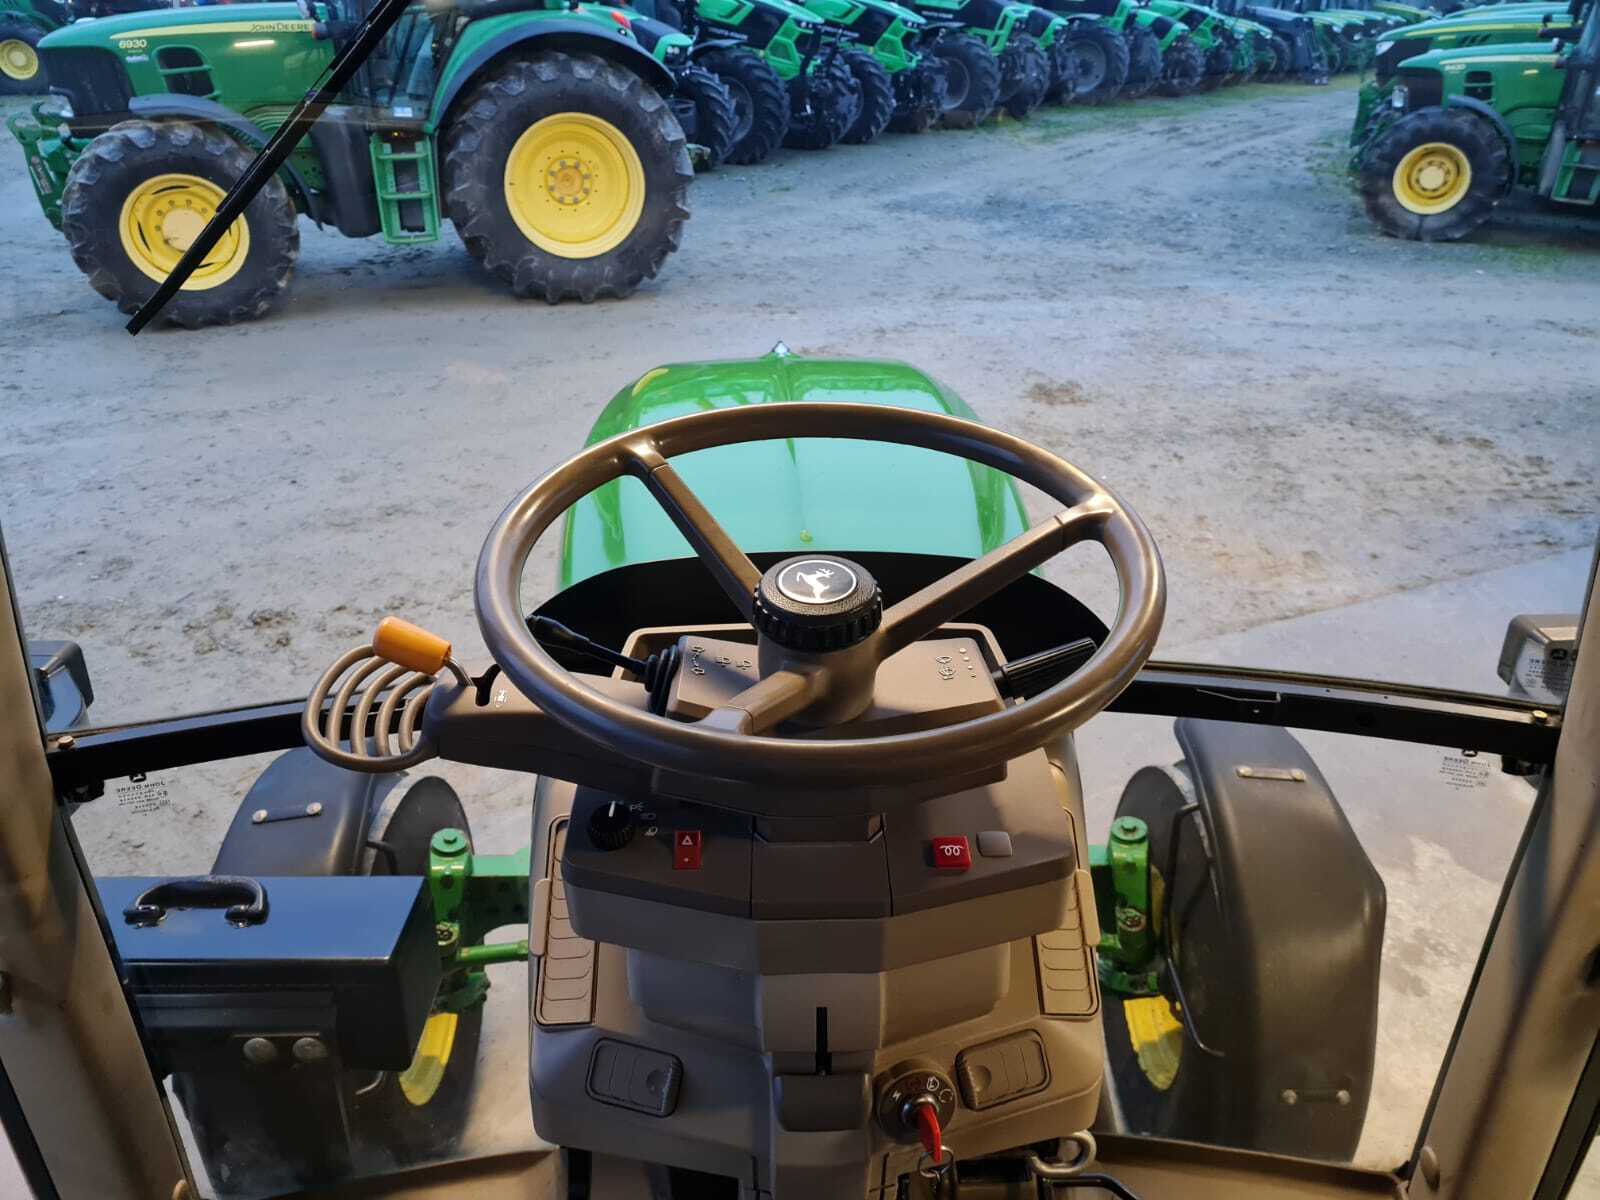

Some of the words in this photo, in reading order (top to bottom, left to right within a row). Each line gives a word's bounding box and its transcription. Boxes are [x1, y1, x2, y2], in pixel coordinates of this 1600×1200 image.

[250, 23, 275, 32] JOHN
[276, 22, 309, 32] DEERE
[118, 38, 148, 49] 6930
